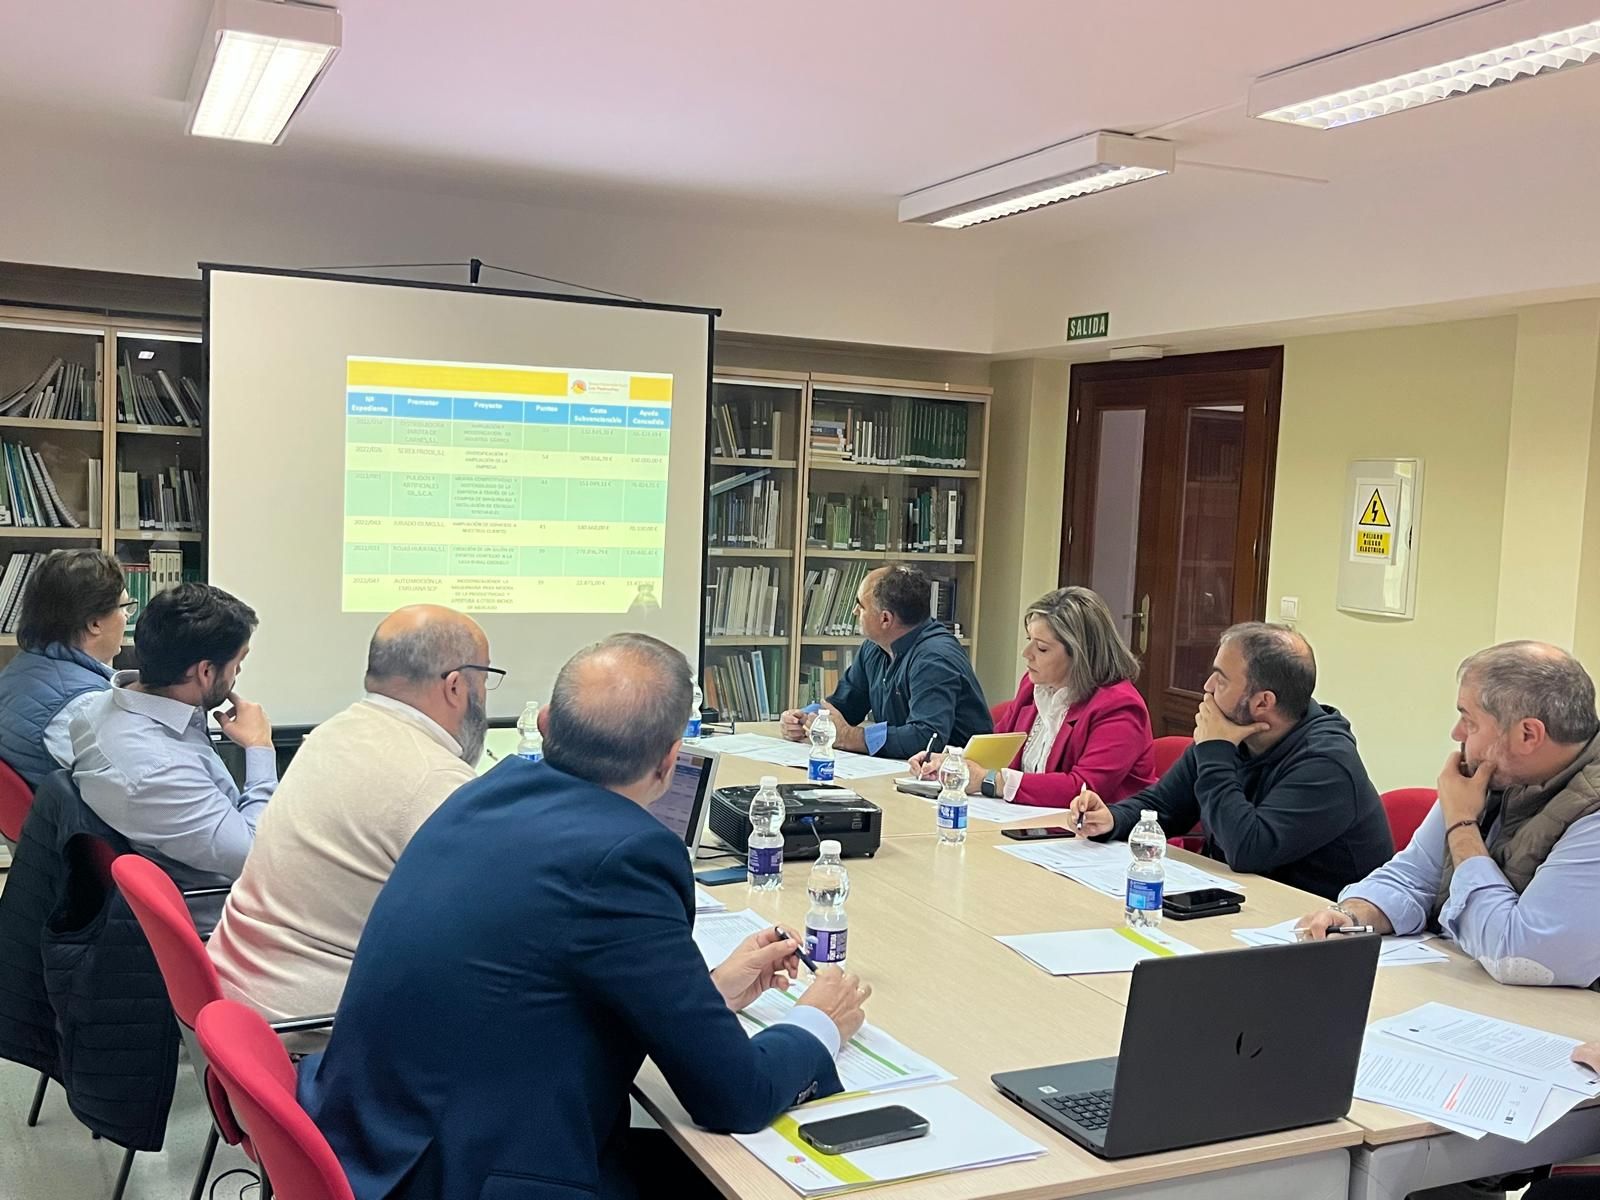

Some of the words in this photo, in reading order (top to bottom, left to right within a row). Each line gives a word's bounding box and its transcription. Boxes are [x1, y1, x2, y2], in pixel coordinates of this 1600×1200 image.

[1070, 316, 1105, 337] SALIDA
[407, 398, 440, 406] Promotor
[473, 400, 503, 410] Proyecto
[351, 404, 388, 413] Expediente
[535, 404, 557, 412] Puntos
[640, 409, 658, 417] Ayuda
[633, 417, 664, 425] Concedida
[1363, 532, 1383, 540] PELIGRO
